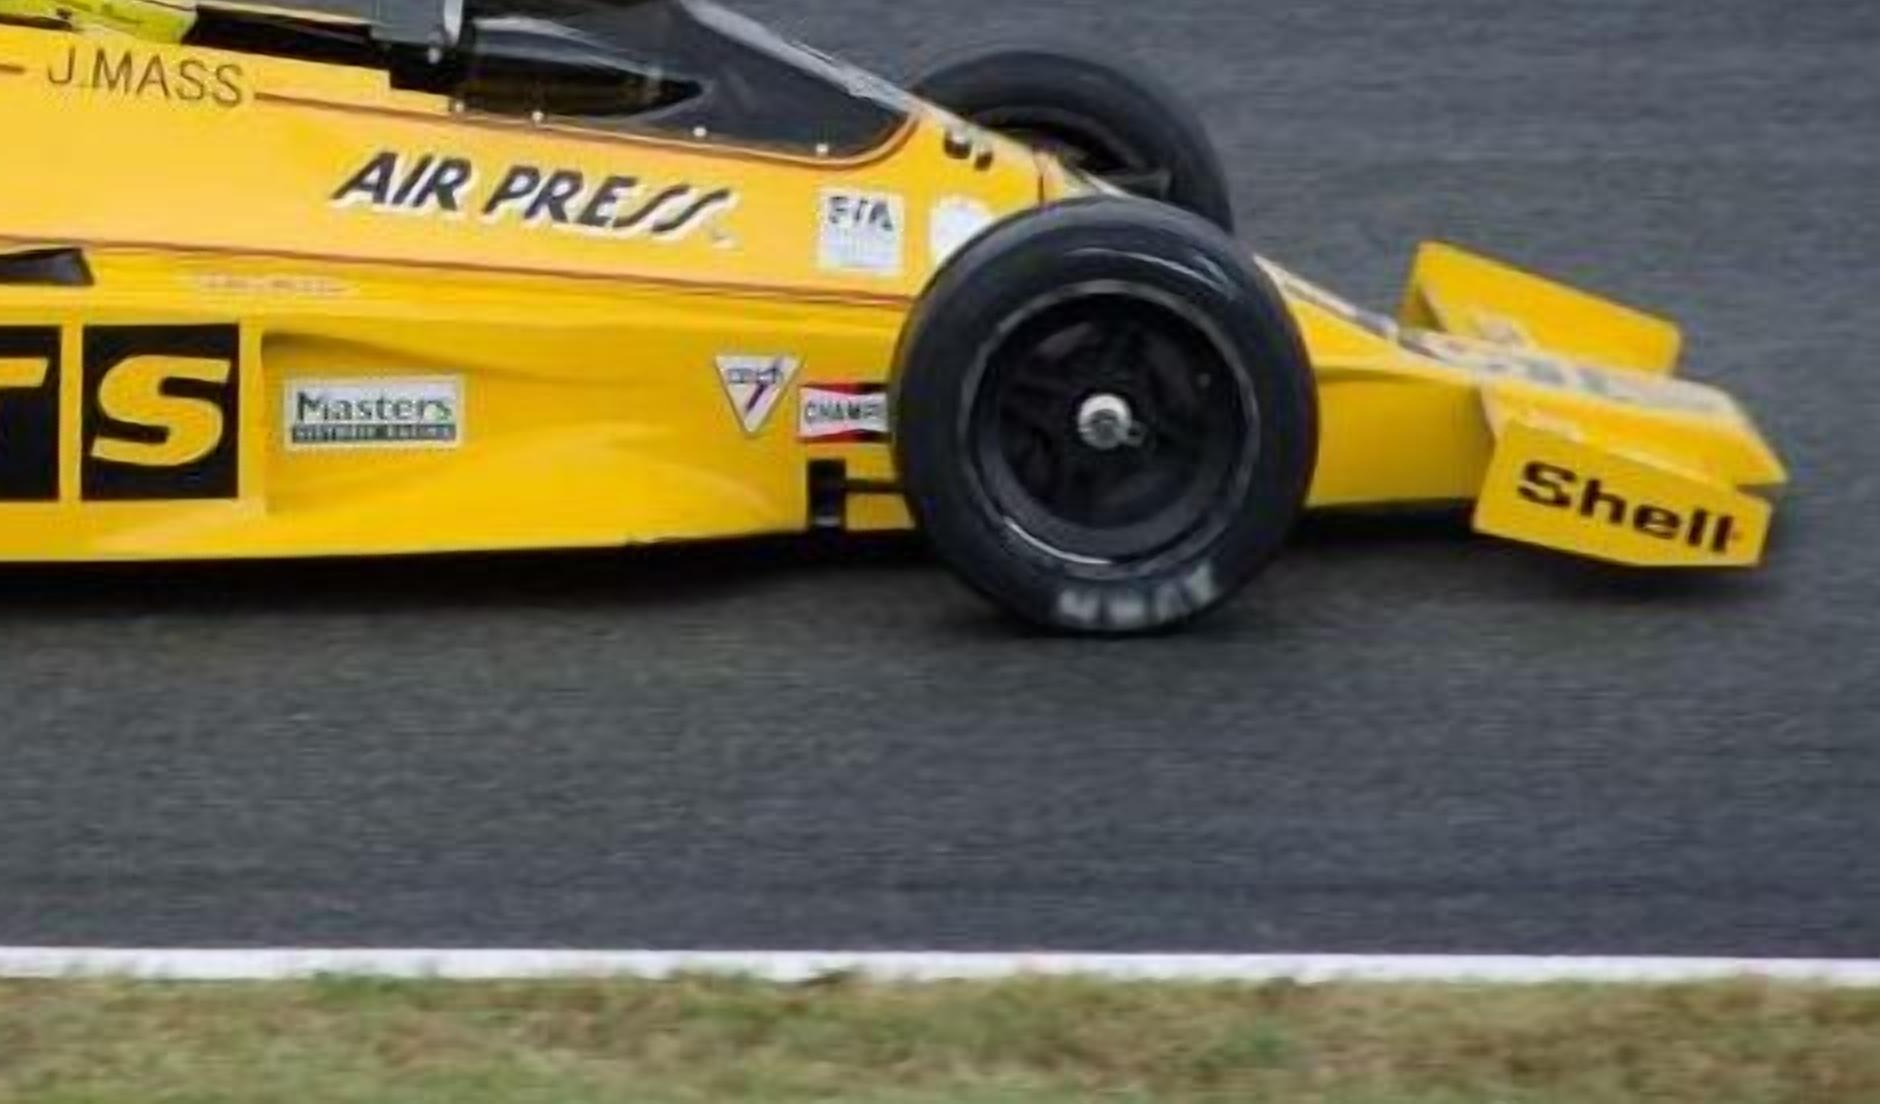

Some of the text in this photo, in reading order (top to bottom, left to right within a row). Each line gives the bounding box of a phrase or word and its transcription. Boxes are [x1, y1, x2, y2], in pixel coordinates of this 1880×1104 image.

[333, 151, 732, 233] AIR PRESS
[297, 391, 453, 423] Masters
[1516, 460, 1735, 553] Shell
